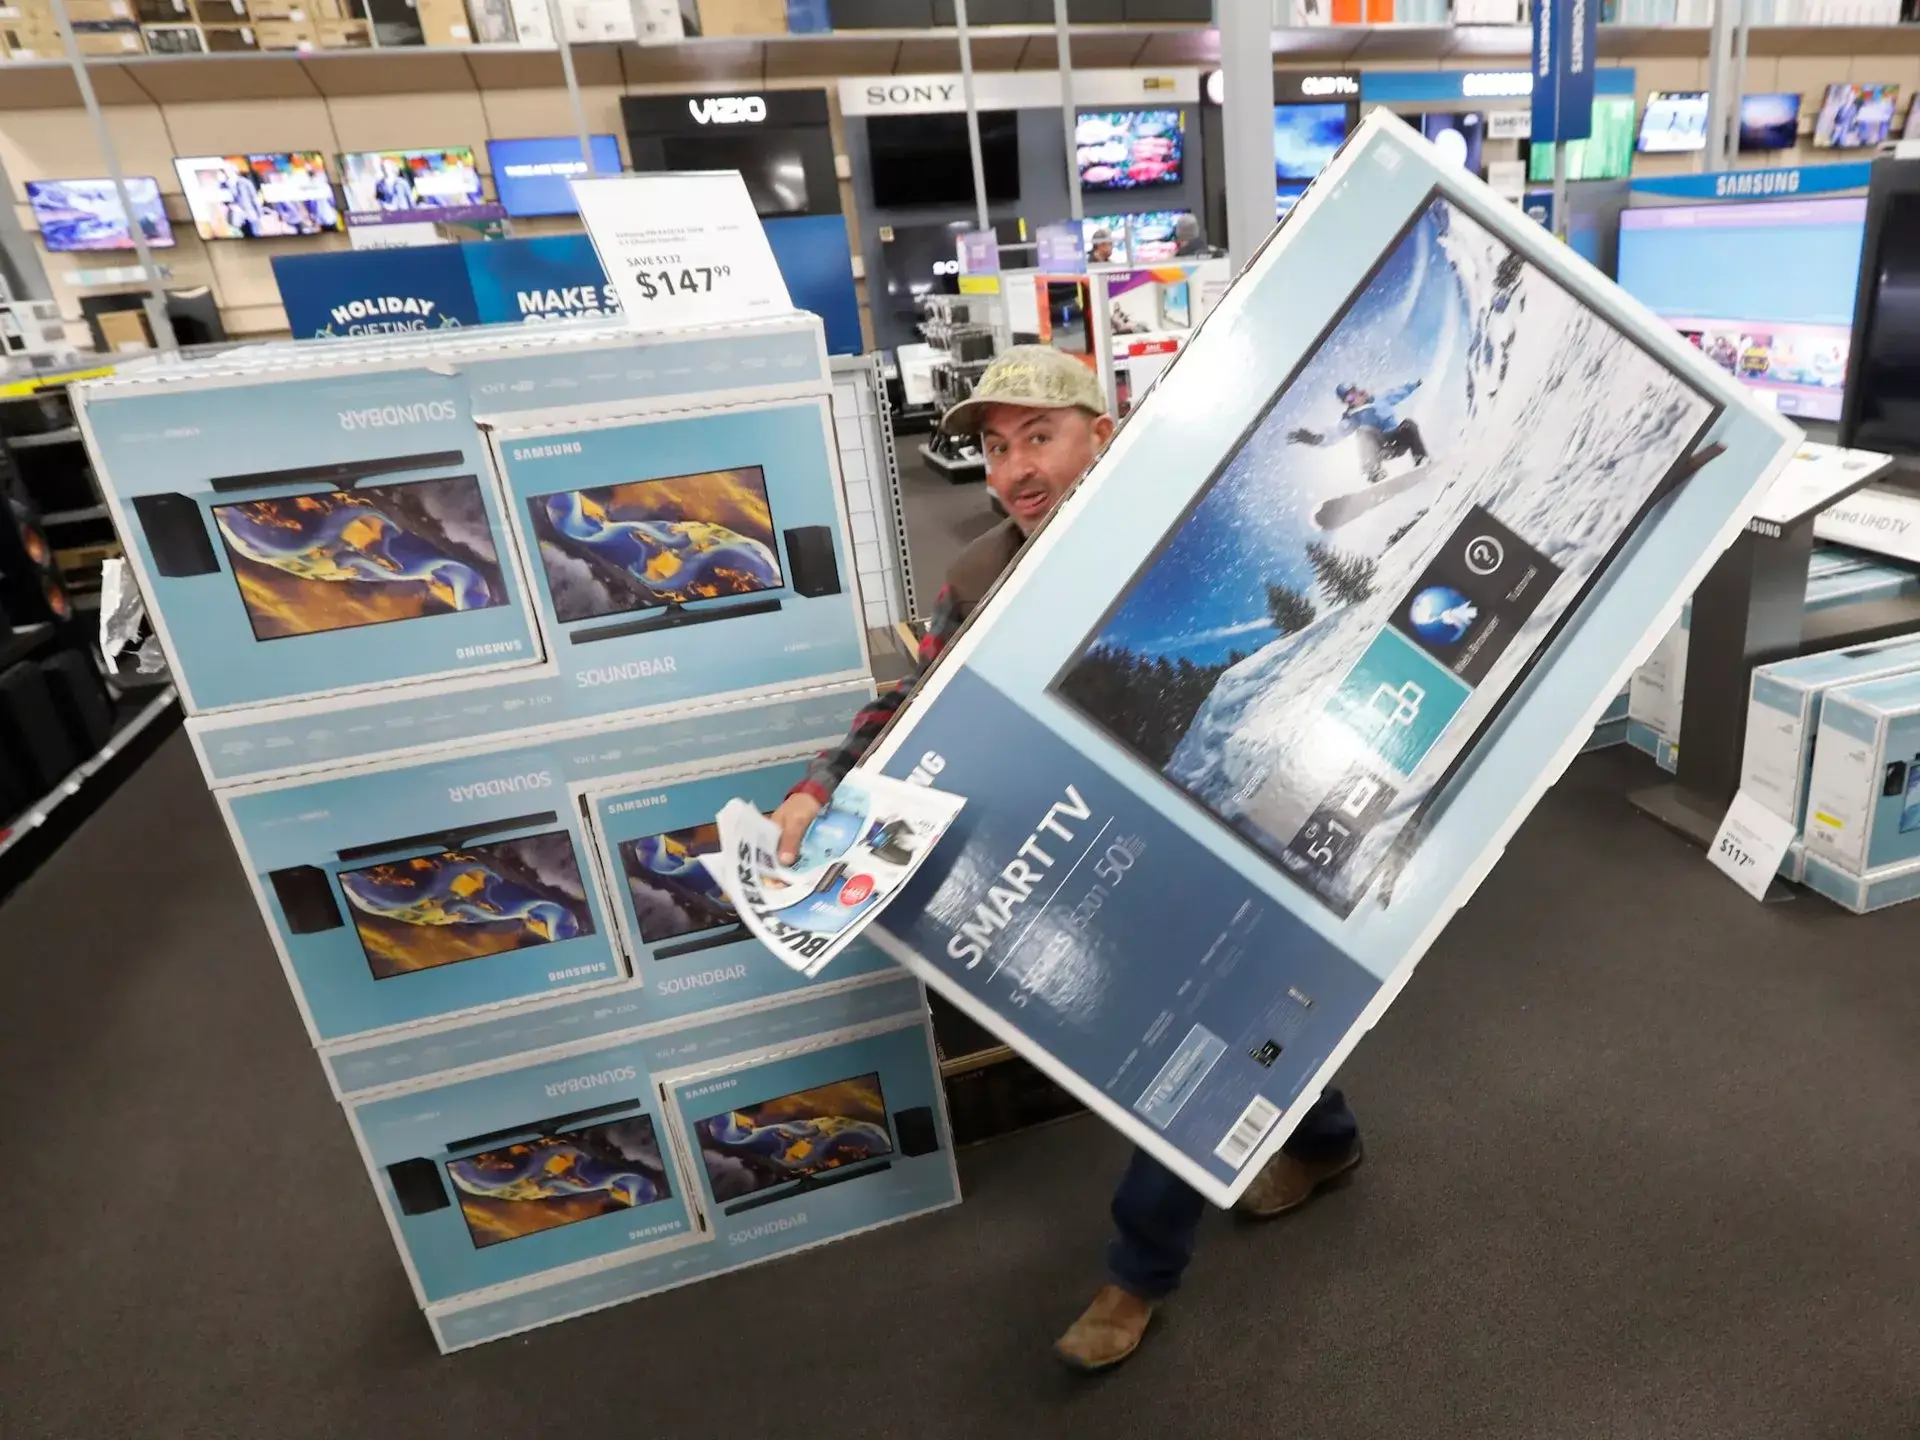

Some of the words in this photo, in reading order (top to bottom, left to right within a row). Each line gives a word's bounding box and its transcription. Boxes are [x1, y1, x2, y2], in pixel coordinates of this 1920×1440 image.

[866, 84, 955, 106] SONY
[689, 96, 766, 124] VIZIO
[1716, 171, 1800, 196] SAMSUNG
[626, 256, 655, 267] SAVE
[655, 254, 681, 265] $132
[933, 261, 958, 275] SO
[331, 296, 435, 325] HOLIDAY
[517, 286, 599, 314] MAKE
[338, 400, 456, 431] SOUNDBAR
[513, 442, 583, 461] SAMSUNG
[1744, 518, 1781, 539] SUNG
[1821, 507, 1857, 524] urved
[1860, 512, 1890, 530] UHD
[1890, 517, 1911, 534] TV
[456, 639, 523, 660] SAMSUNG
[576, 656, 677, 688] SOUNDBAR
[449, 771, 552, 803] SOUNDBAR
[608, 795, 668, 814] SAMSUNG
[1307, 819, 1350, 866] 5-1
[947, 834, 1055, 970] SMART
[1036, 783, 1092, 842] TV
[548, 961, 607, 982] SAMSUNG
[657, 964, 747, 996] SOUNDBAR
[545, 1065, 638, 1098] SOUNDBAR
[685, 1078, 738, 1100] SAMSUNG
[628, 1219, 681, 1241] SAMSUNG
[728, 1212, 809, 1247] SOUNDBAR
